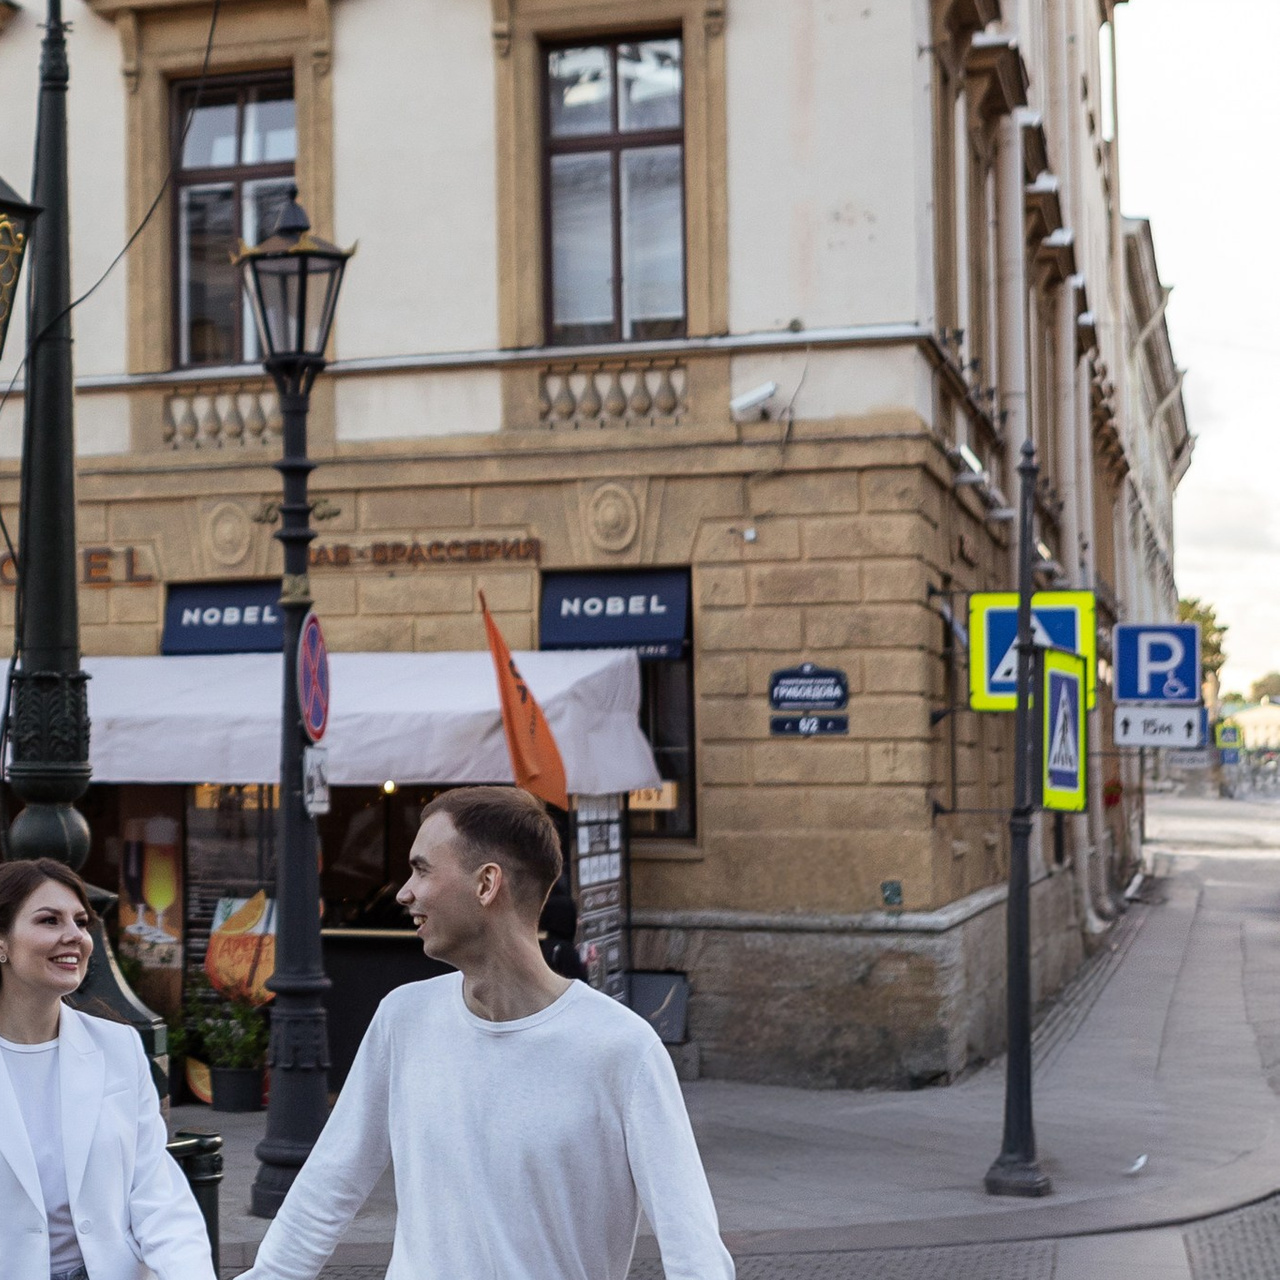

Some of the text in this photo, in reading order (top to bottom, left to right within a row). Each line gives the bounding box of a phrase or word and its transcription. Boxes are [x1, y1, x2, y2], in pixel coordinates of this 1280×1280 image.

[181, 605, 279, 627] NOBEL
[561, 594, 668, 617] NOBEL
[1137, 631, 1185, 696] P
